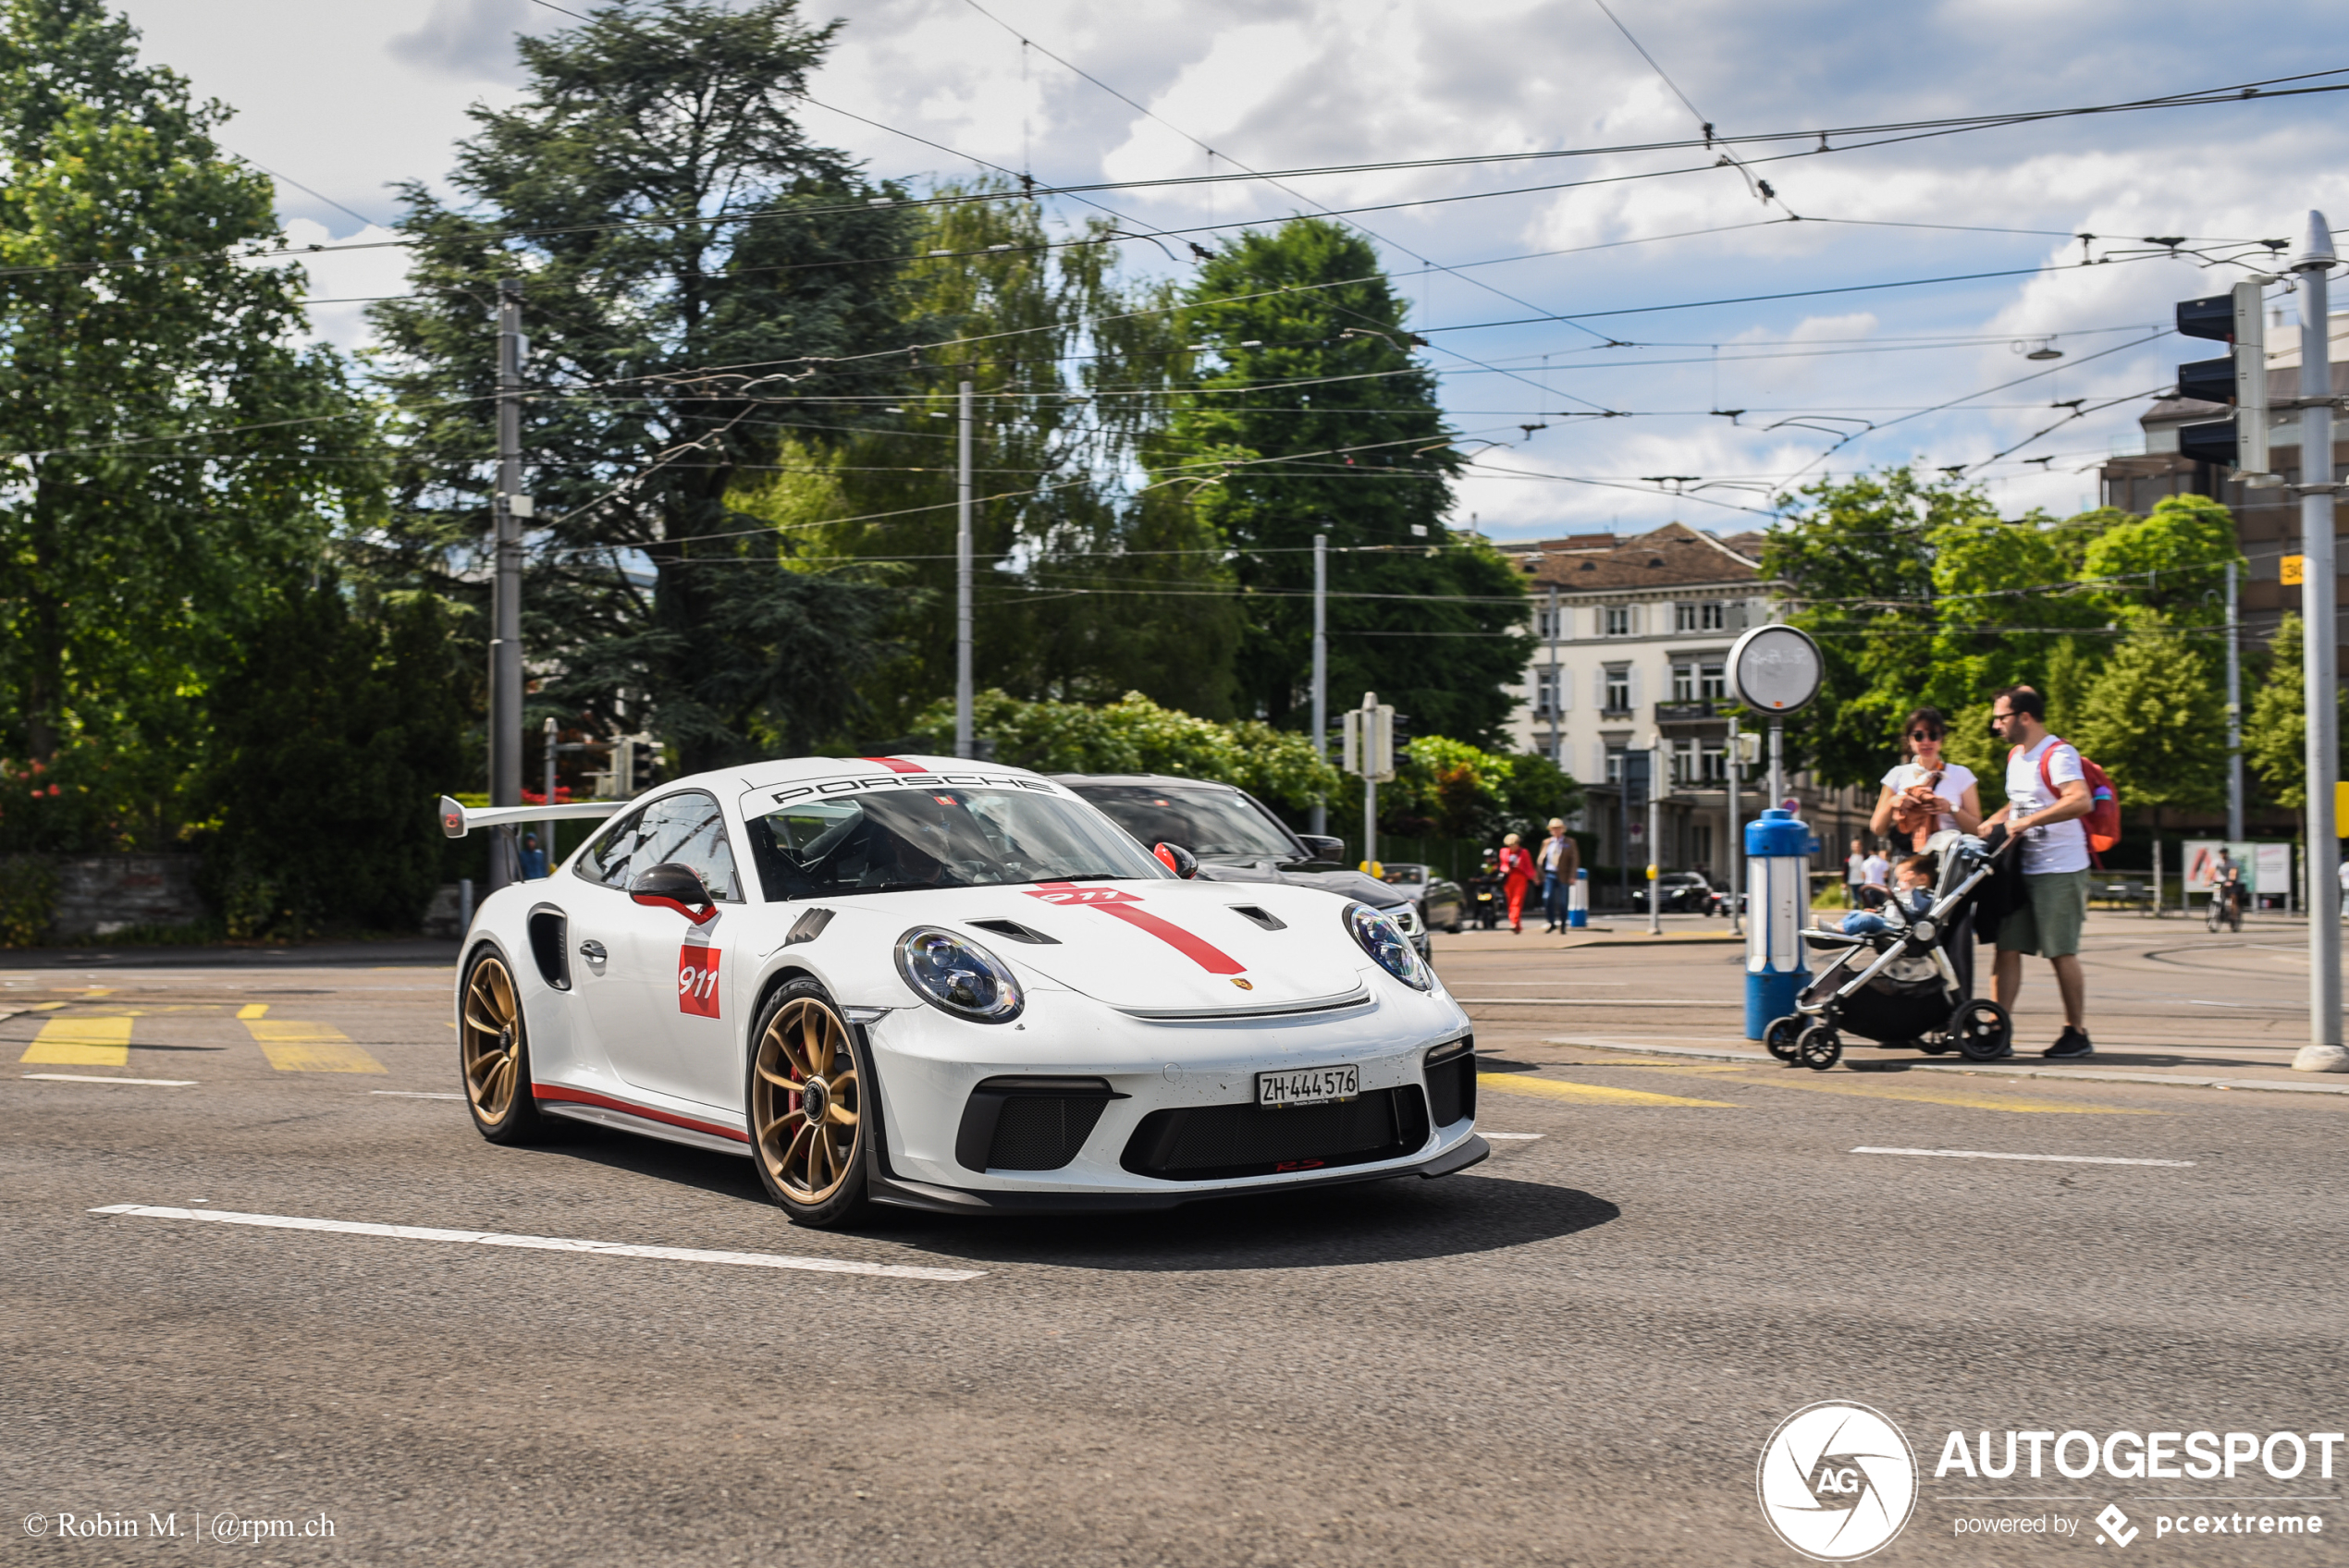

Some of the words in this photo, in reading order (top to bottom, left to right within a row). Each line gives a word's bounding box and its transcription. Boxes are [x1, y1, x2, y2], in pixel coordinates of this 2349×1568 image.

[771, 776, 1058, 804] PORSCHE
[1039, 890, 1119, 903] 911
[679, 965, 719, 999] 911
[1274, 1158, 1324, 1172] RS
